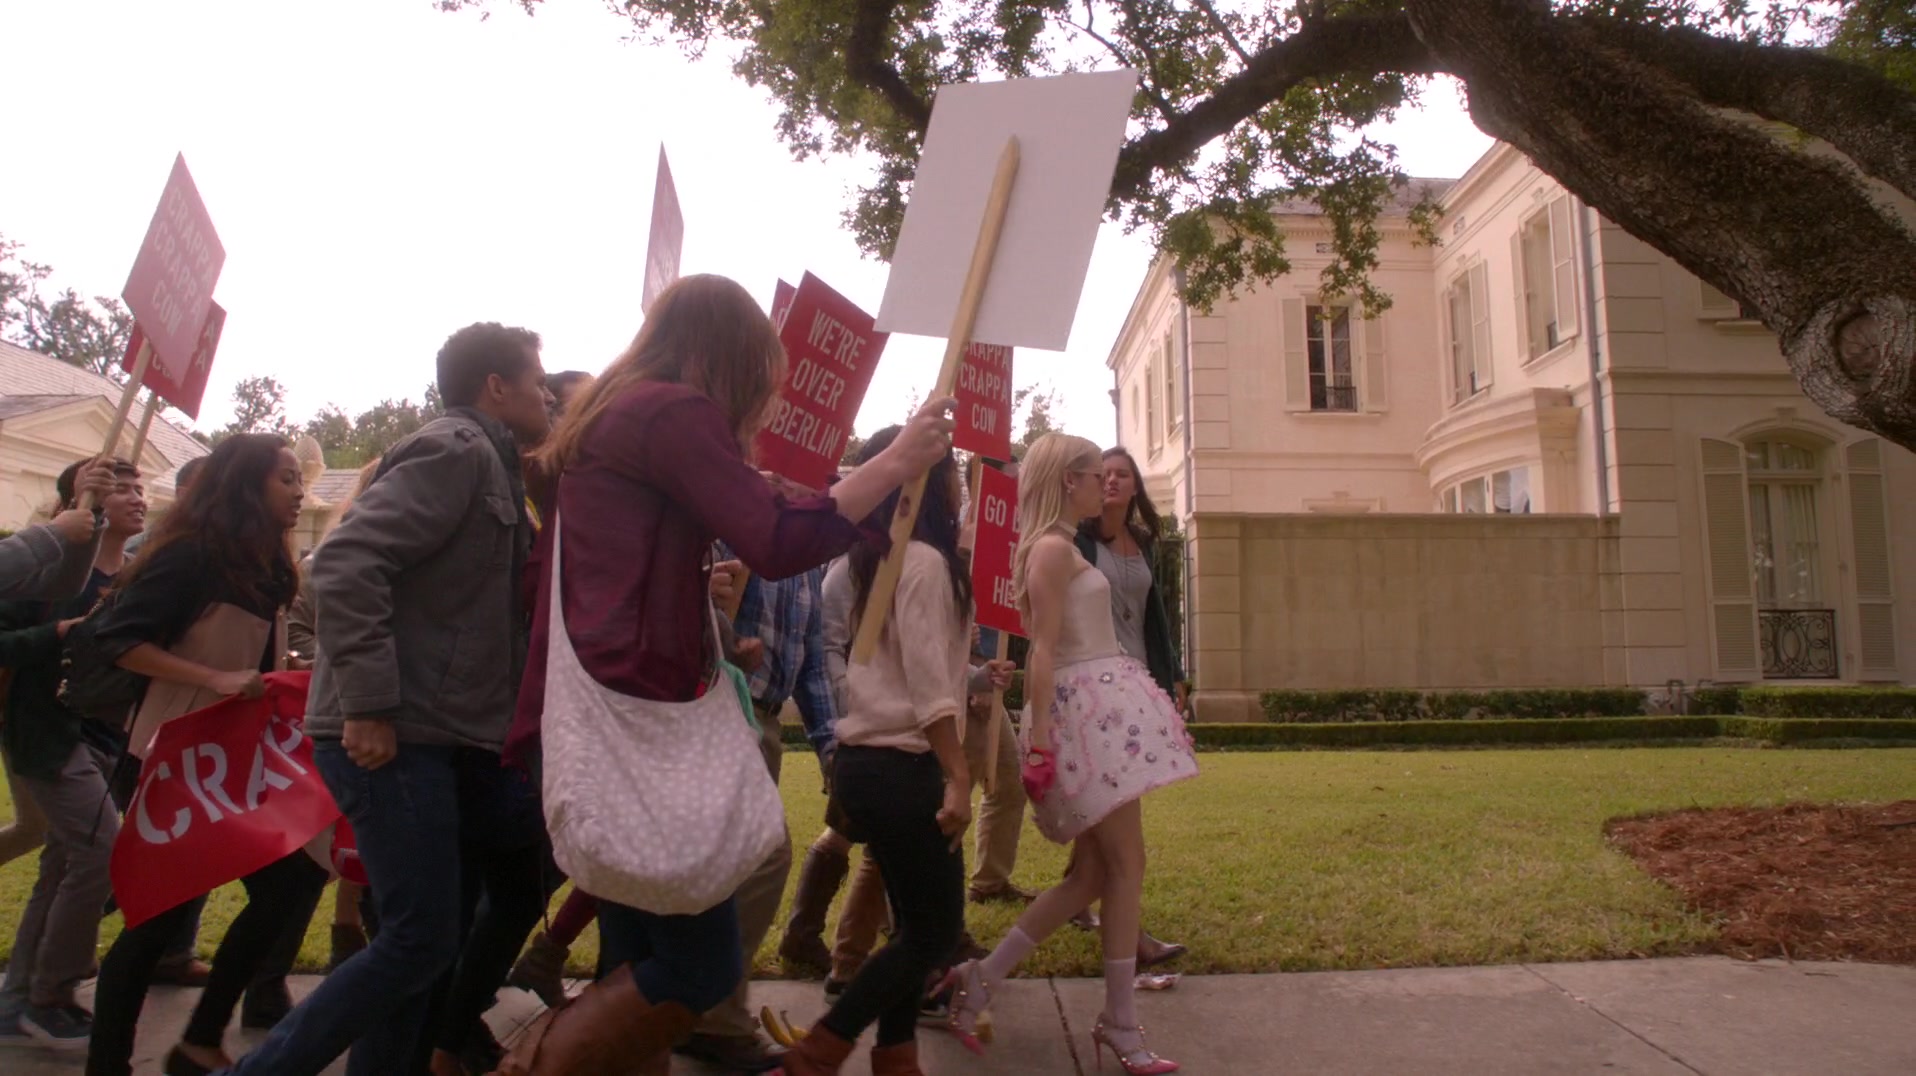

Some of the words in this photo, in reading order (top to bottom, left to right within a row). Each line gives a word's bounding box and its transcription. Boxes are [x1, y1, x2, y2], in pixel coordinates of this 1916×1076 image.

[167, 186, 214, 289] CRAPPA
[153, 221, 202, 328] CRAPPA
[152, 279, 182, 337] COW
[807, 308, 867, 371] WE'RE
[965, 342, 1009, 372] RAPPA
[792, 357, 846, 412] OVER
[959, 361, 1008, 403] CRAPPA
[971, 402, 997, 435] COW
[985, 494, 1007, 528] GO
